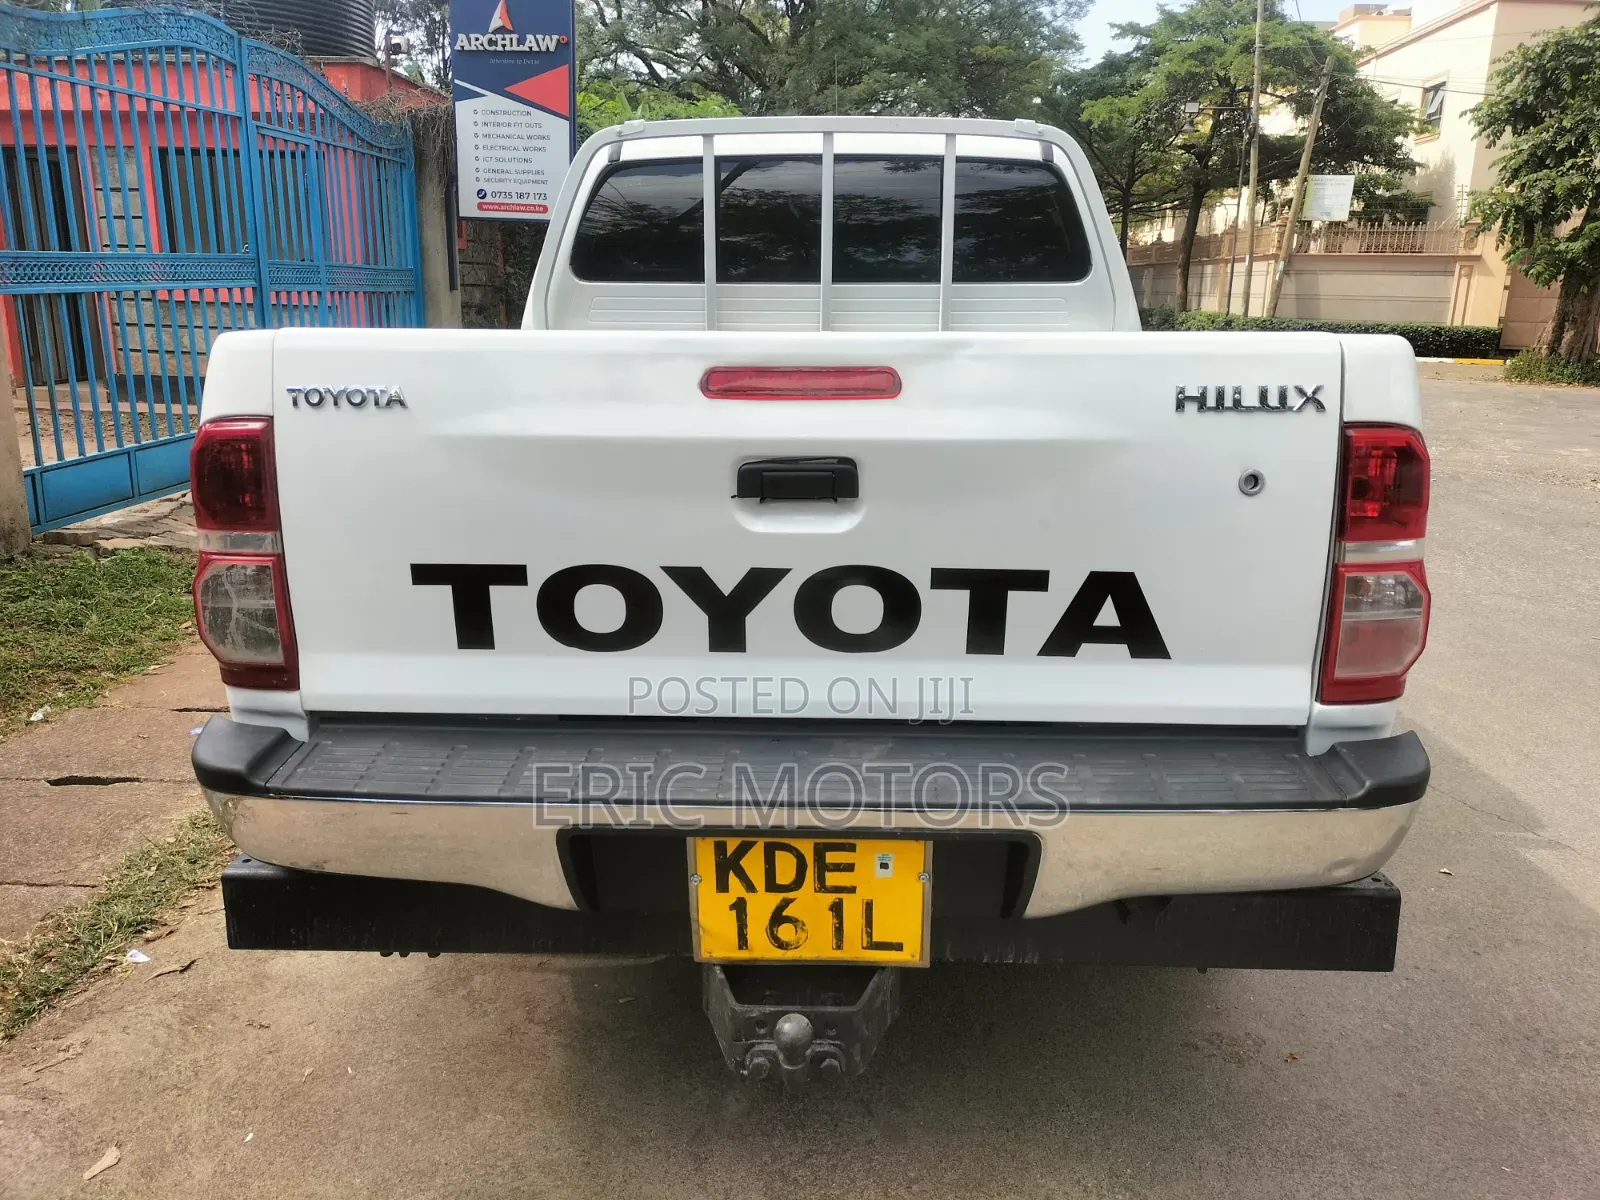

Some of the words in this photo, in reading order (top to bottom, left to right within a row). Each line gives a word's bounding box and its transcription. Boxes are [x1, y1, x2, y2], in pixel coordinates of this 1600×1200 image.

[454, 33, 560, 53] ARCHLAW
[481, 109, 532, 117] CONSTRUCTION
[482, 203, 544, 212] www.archlaw.co.ke
[491, 190, 513, 199] 0735
[516, 192, 530, 200] 187
[533, 192, 548, 200] 173
[285, 384, 408, 411] TOYOTA
[1175, 384, 1326, 413] HILUX
[411, 564, 1170, 659] TOYOTA
[713, 840, 857, 894] KDE
[729, 896, 904, 952] 161L
